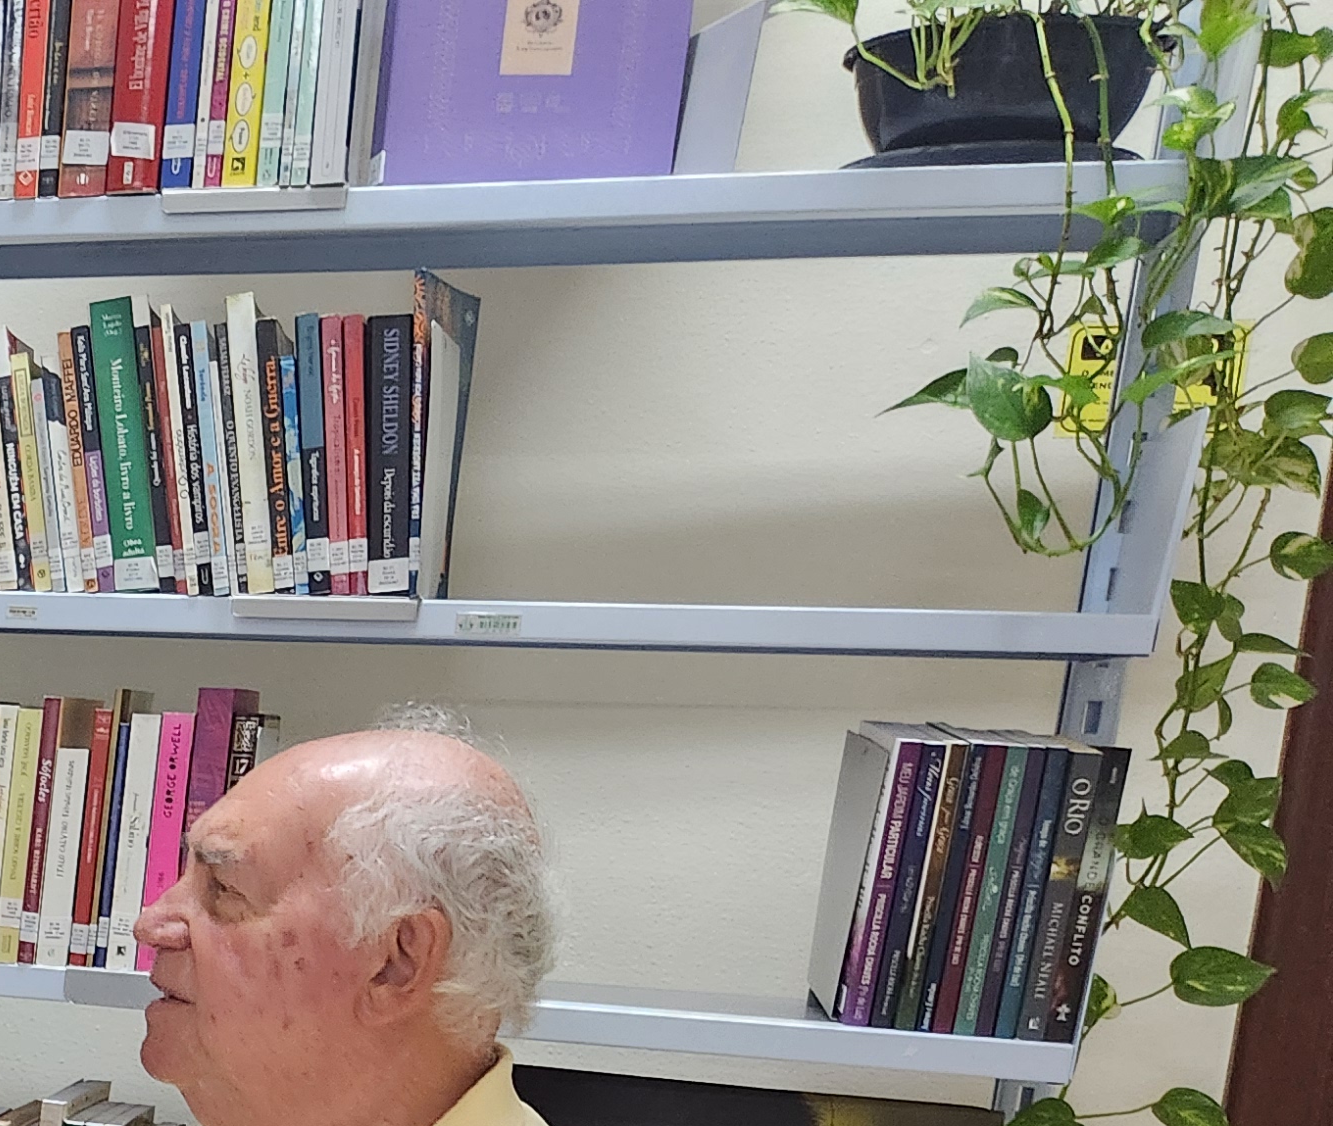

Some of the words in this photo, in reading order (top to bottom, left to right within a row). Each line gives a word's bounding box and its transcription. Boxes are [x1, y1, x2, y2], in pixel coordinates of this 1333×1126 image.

[381, 328, 400, 380] SIDNEY
[61, 358, 76, 403] MAFFEI
[109, 358, 126, 412] Monteiro
[225, 420, 235, 428] O
[242, 389, 253, 418] NOAH
[381, 386, 400, 455] SHELDON
[67, 409, 82, 468] EDUARDO
[114, 414, 129, 460] Lobato,
[186, 424, 200, 463] História
[226, 430, 238, 470] QUINTO
[245, 419, 257, 461] GORDON
[4, 442, 20, 492] NINGUÉM
[120, 461, 133, 488] livro
[189, 464, 201, 480] dos
[205, 462, 215, 477] A
[380, 467, 397, 500] Depois
[9, 493, 21, 510] EM
[122, 490, 131, 500] a
[122, 502, 136, 530] livro
[190, 481, 205, 524] vampiros
[229, 471, 244, 541] EVANGELISTA
[383, 501, 394, 514] da
[11, 511, 24, 540] CASA
[207, 484, 221, 555] SOGRA
[383, 514, 396, 558] escuridão
[169, 723, 182, 770] ORWELL
[37, 758, 53, 803] Sófocles
[899, 762, 913, 783] MEU
[1071, 778, 1093, 796] O
[163, 774, 177, 819] GEORGE
[890, 784, 909, 819] JARDIM
[1063, 798, 1091, 836] RIO
[879, 819, 903, 880] PARTICULAR
[1085, 832, 1106, 889] GRANDE
[1041, 902, 1065, 958] MICHAEL
[1067, 895, 1094, 967] CONFLITO
[1033, 962, 1055, 1000] NEALE
